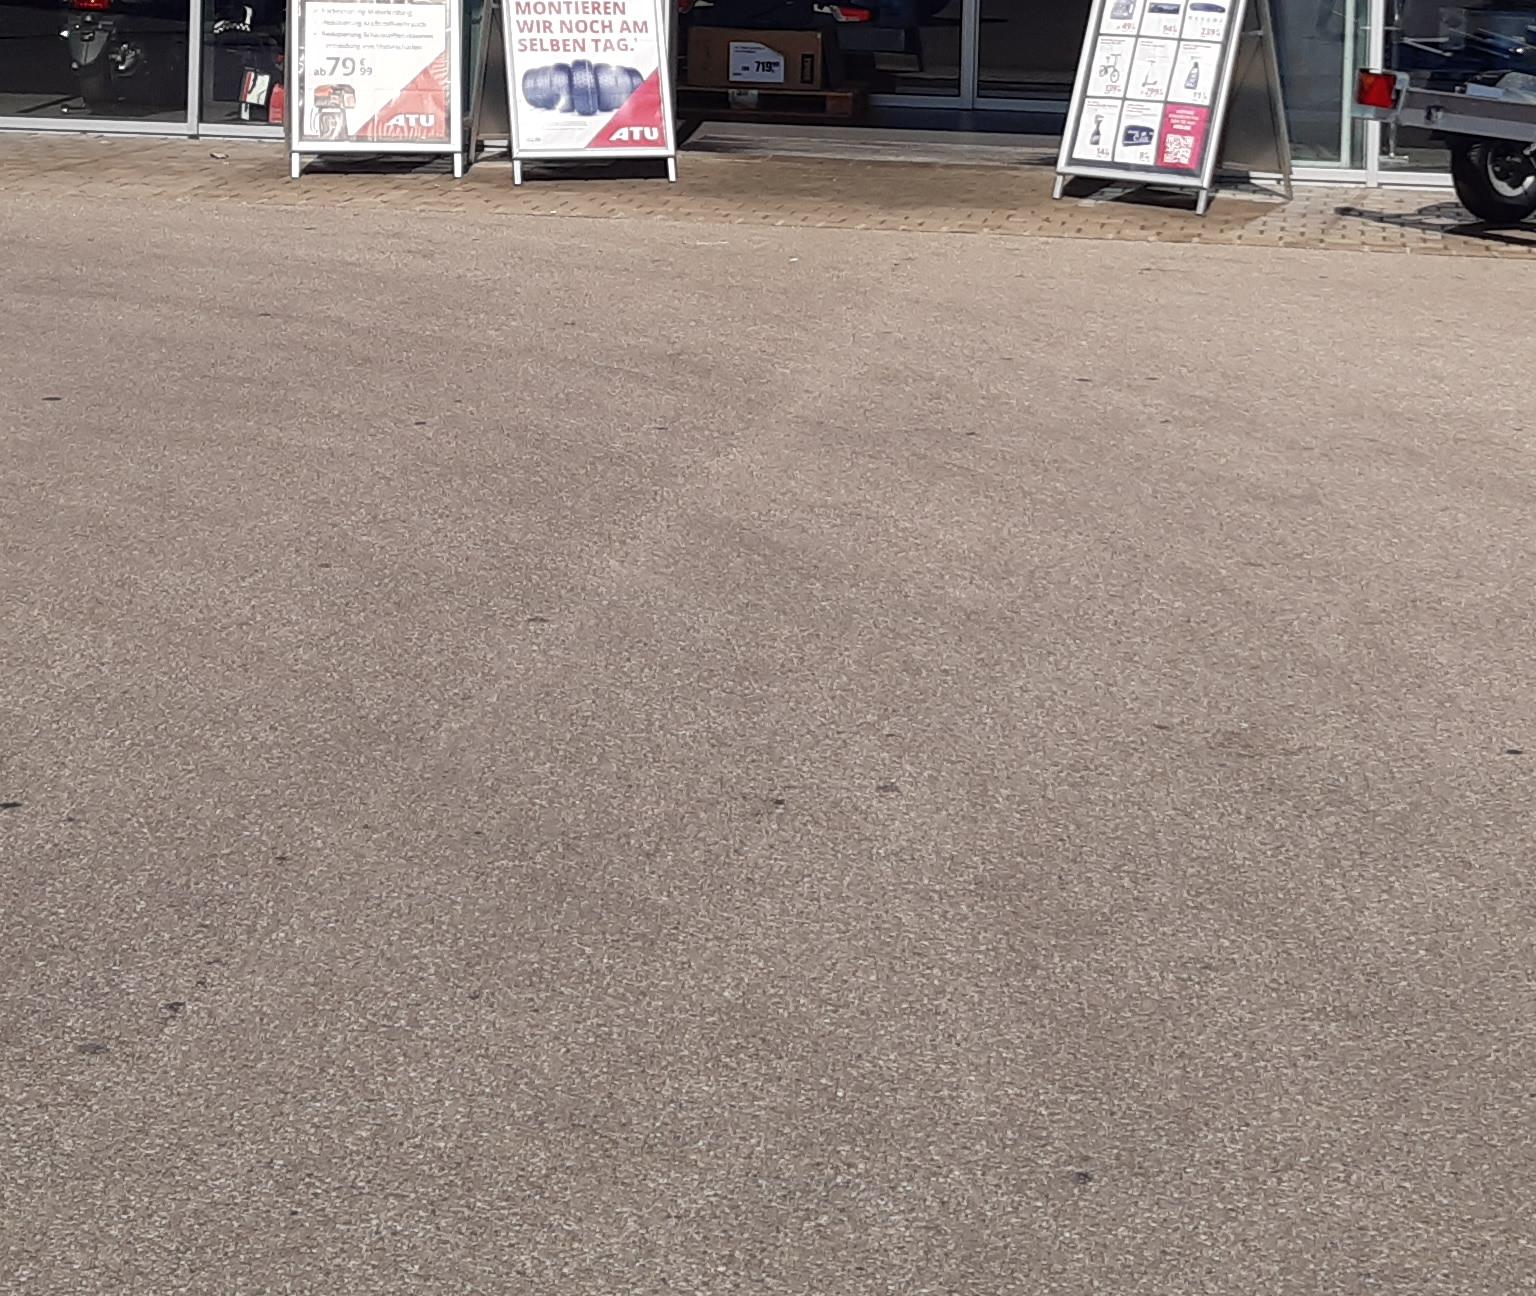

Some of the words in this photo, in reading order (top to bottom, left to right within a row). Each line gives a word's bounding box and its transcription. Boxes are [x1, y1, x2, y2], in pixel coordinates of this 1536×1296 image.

[515, 1, 626, 15] MONTIEREN
[516, 19, 553, 34] WIR
[560, 19, 613, 34] NOCH
[619, 20, 649, 34] AM
[518, 38, 586, 52] SELBEN
[314, 68, 326, 76] ab
[326, 57, 356, 77] 79
[386, 114, 436, 128] ATU
[609, 126, 659, 142] ATU
